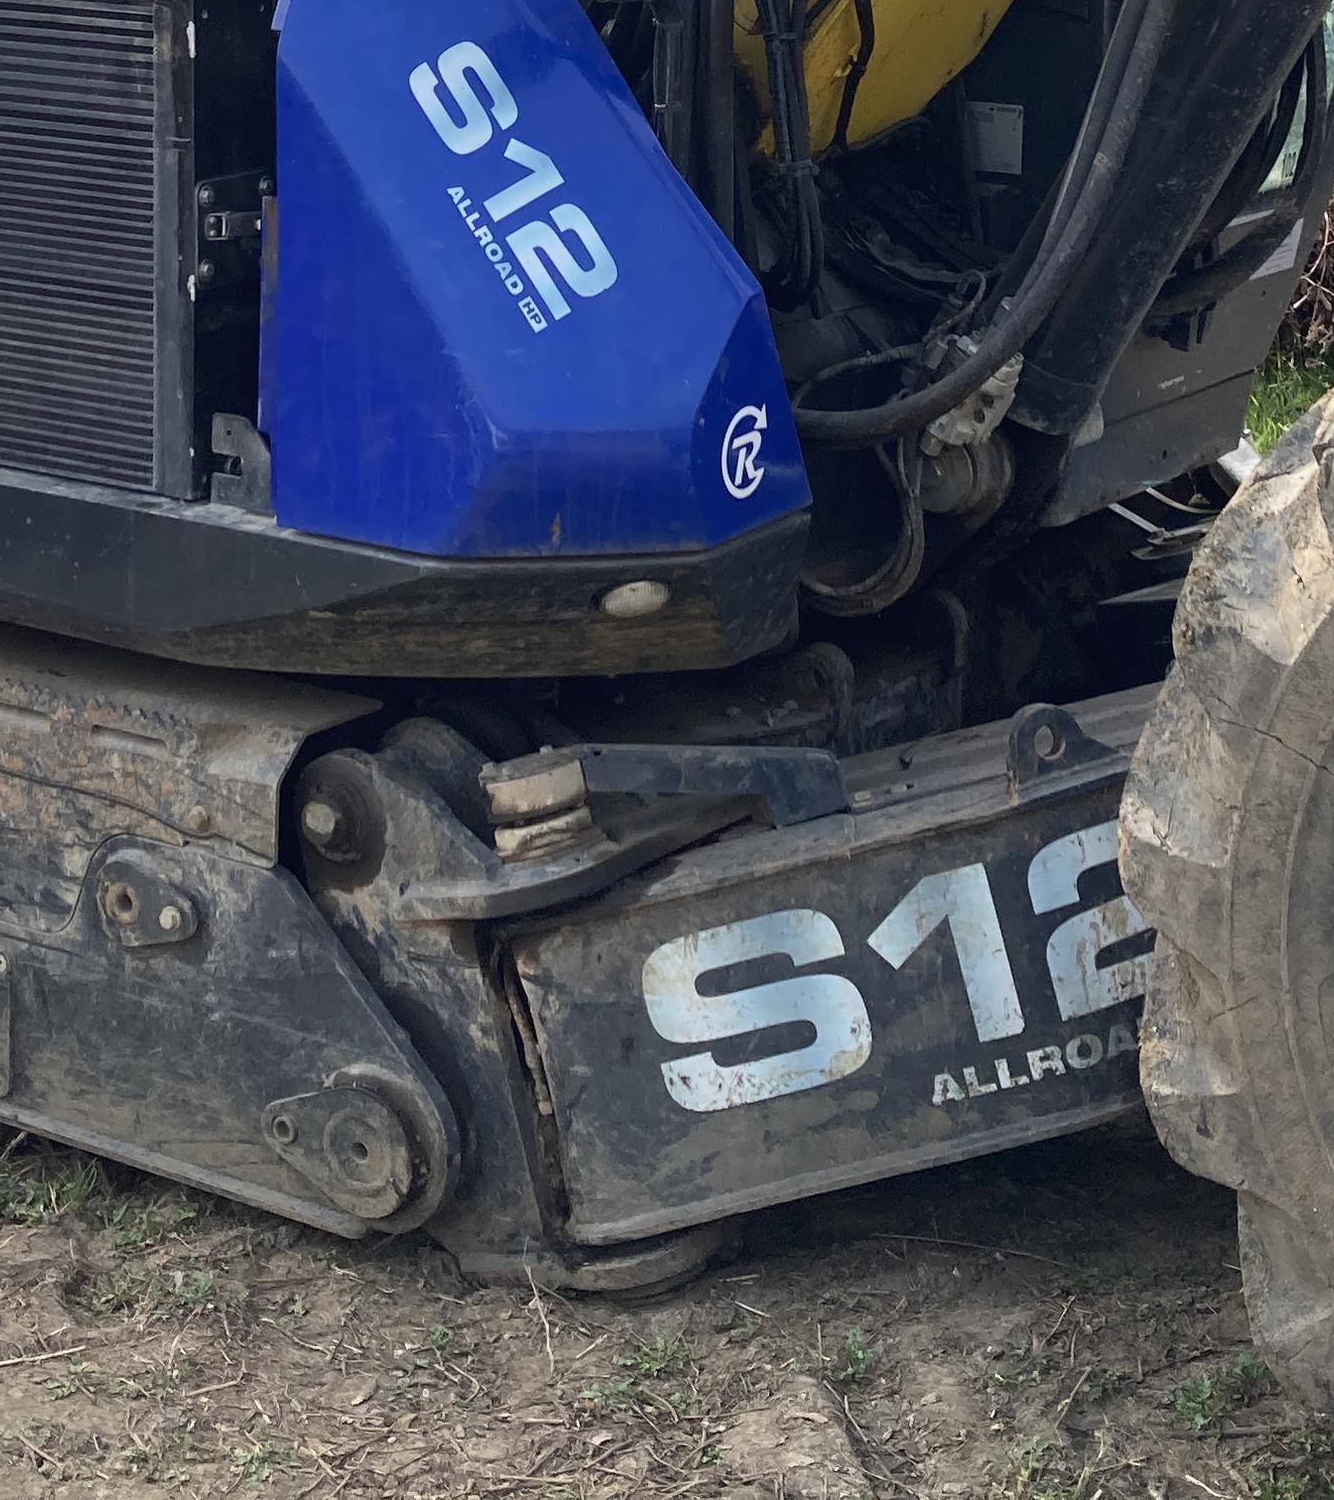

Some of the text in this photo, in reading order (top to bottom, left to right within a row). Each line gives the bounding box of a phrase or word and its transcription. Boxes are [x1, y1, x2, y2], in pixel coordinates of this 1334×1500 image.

[408, 41, 618, 321] S12
[447, 185, 546, 330] ALLROAD HP
[642, 821, 1158, 1112] S12
[931, 1024, 1139, 1106] ALLROA
